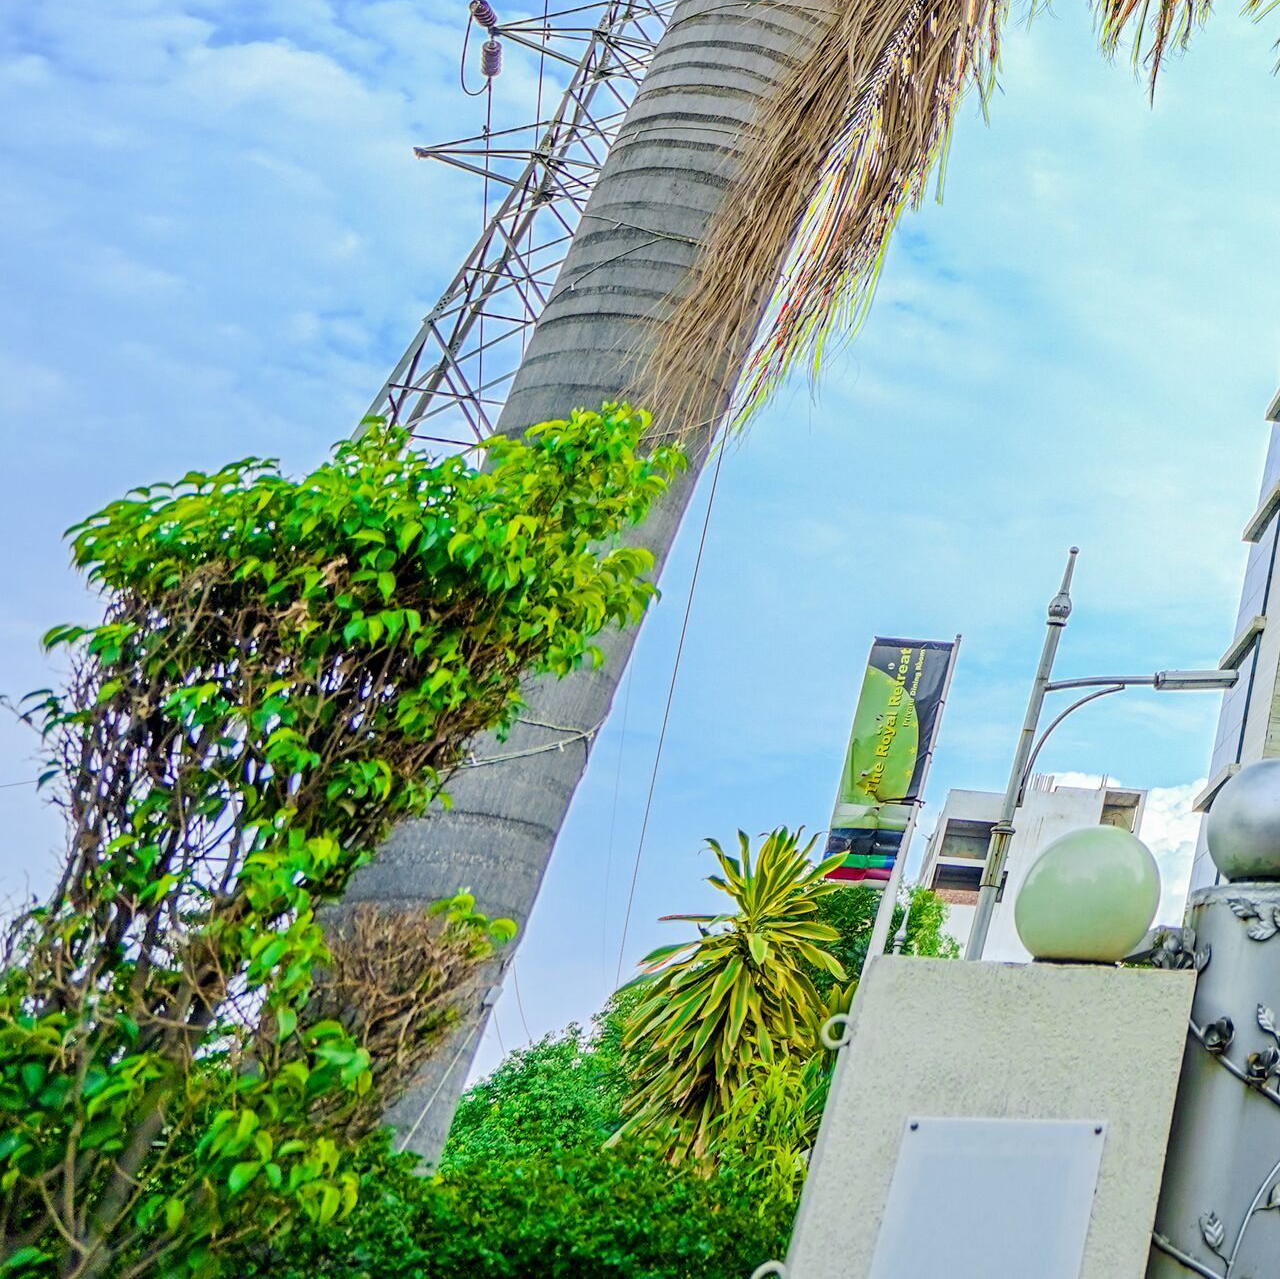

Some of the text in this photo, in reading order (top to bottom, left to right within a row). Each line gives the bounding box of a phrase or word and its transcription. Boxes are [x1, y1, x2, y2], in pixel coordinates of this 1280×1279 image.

[865, 646, 912, 795] The Royal Retreat
[910, 671, 921, 696] Dining
